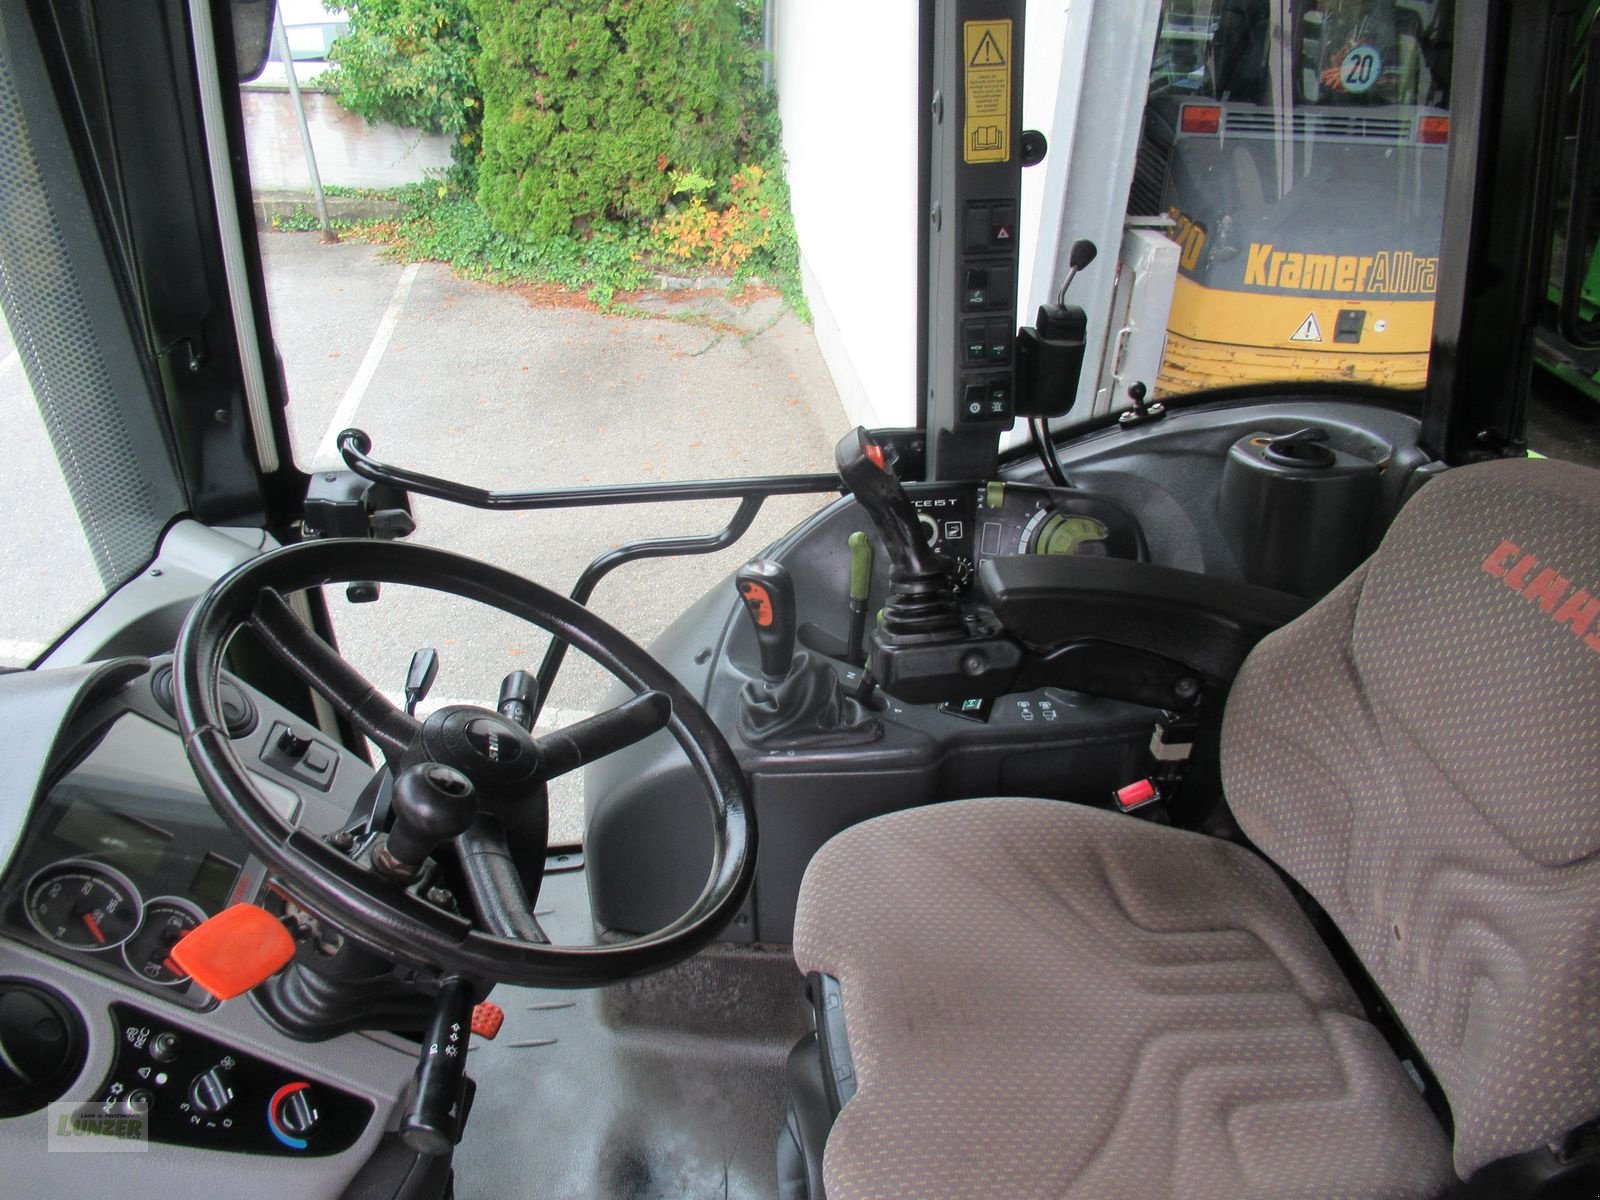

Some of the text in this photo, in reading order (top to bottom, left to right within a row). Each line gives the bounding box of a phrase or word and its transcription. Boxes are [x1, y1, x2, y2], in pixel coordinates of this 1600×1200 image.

[1346, 53, 1374, 84] 20
[910, 499, 933, 508] CE
[134, 1027, 150, 1049] REC
[180, 1102, 191, 1112] 3
[191, 1115, 202, 1125] 2
[206, 1120, 216, 1128] 1
